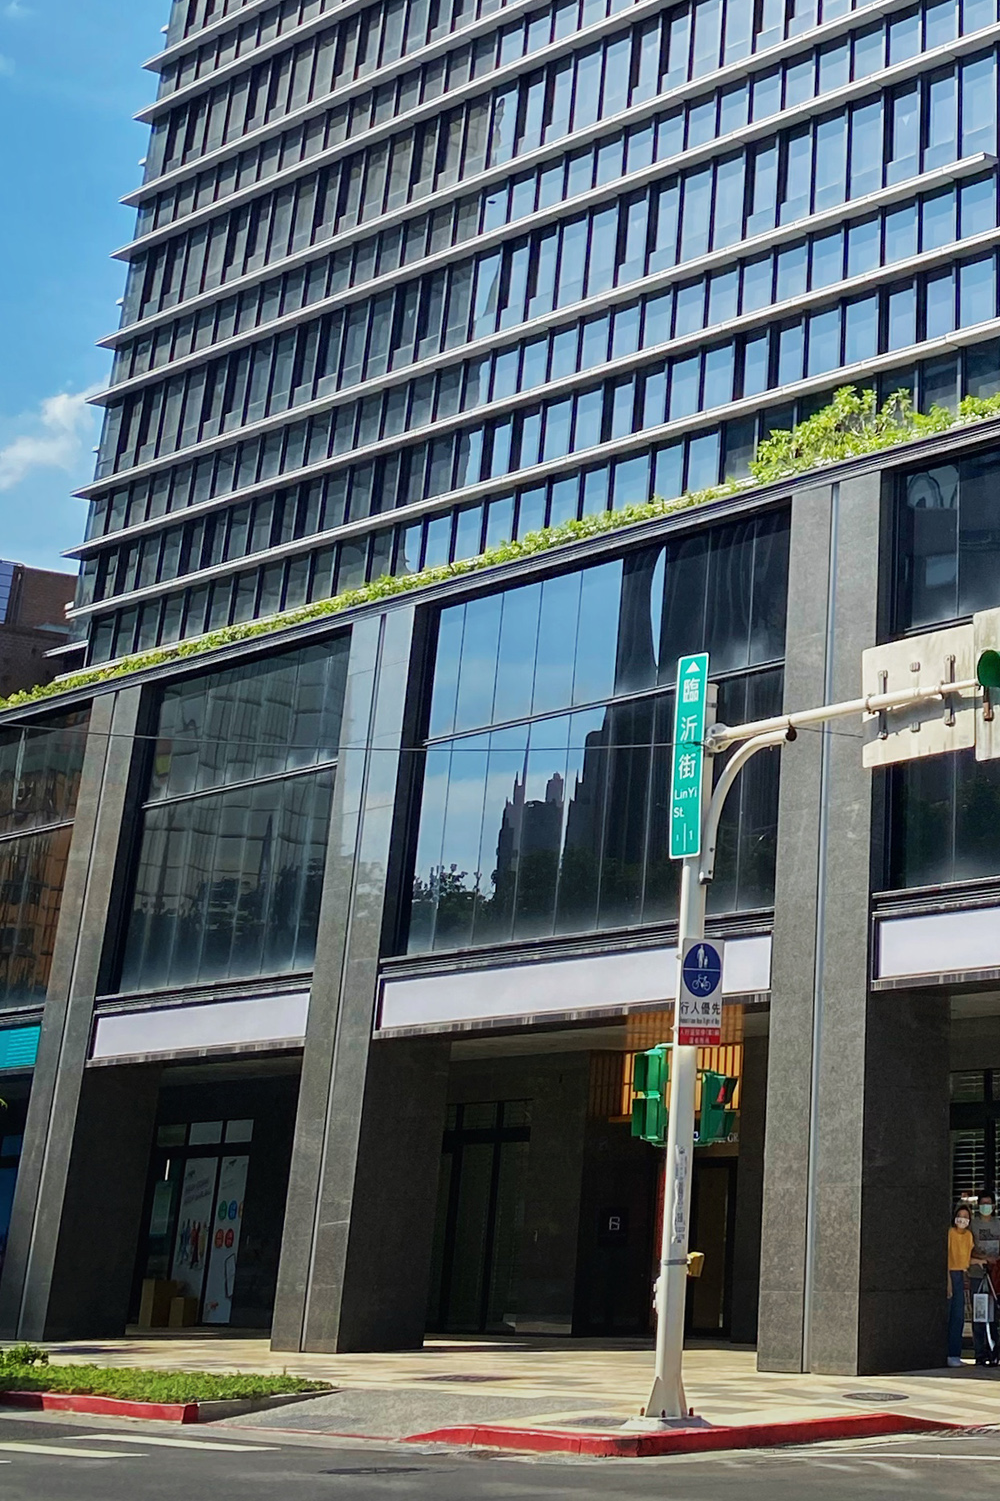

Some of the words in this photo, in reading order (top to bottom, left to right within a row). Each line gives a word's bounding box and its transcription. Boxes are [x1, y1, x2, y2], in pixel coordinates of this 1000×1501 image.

[678, 678, 701, 780] 臨沂街
[680, 1001, 721, 1016] 行人優先
